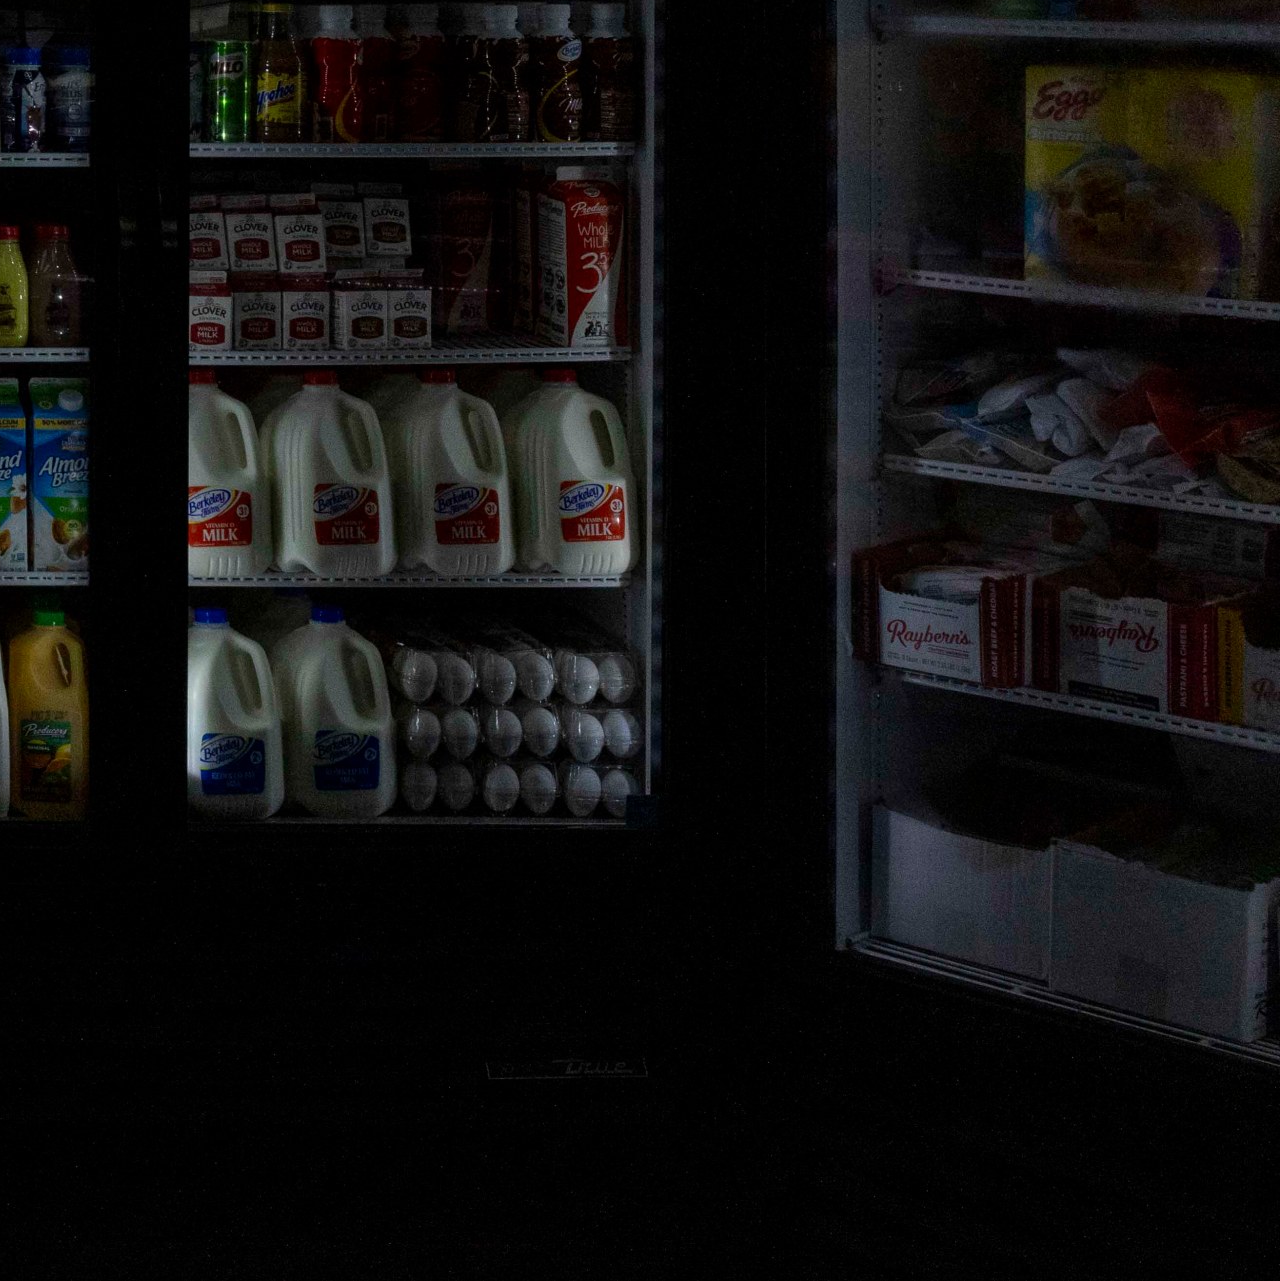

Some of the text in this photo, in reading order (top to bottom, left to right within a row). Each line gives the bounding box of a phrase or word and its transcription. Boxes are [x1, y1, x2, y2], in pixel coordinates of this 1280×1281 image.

[1033, 81, 1104, 121] Eggo
[324, 211, 357, 221] CLOVER
[371, 208, 404, 218] CLOVER
[234, 223, 268, 234] CLOVER
[283, 224, 318, 235] CLOVER
[578, 222, 614, 236] Whole
[192, 246, 214, 254] MILK
[192, 307, 227, 318] CLOVER
[241, 302, 276, 313] CLOVER
[290, 302, 325, 313] CLOVER
[351, 302, 383, 312] CLOVER
[393, 302, 427, 312] CLOVER
[196, 331, 218, 339] MILK
[248, 325, 269, 333] MILK
[52, 470, 90, 488] Breez
[188, 492, 225, 513] Berkeley
[563, 486, 599, 509] Berkeley
[202, 527, 238, 542] MILK
[331, 526, 366, 540] MILK
[452, 525, 486, 540] MILK
[577, 523, 612, 536] MILK
[887, 619, 970, 651] Raybern's
[1179, 623, 1187, 656] CHEESE
[1179, 665, 1188, 708] PASTRAMI
